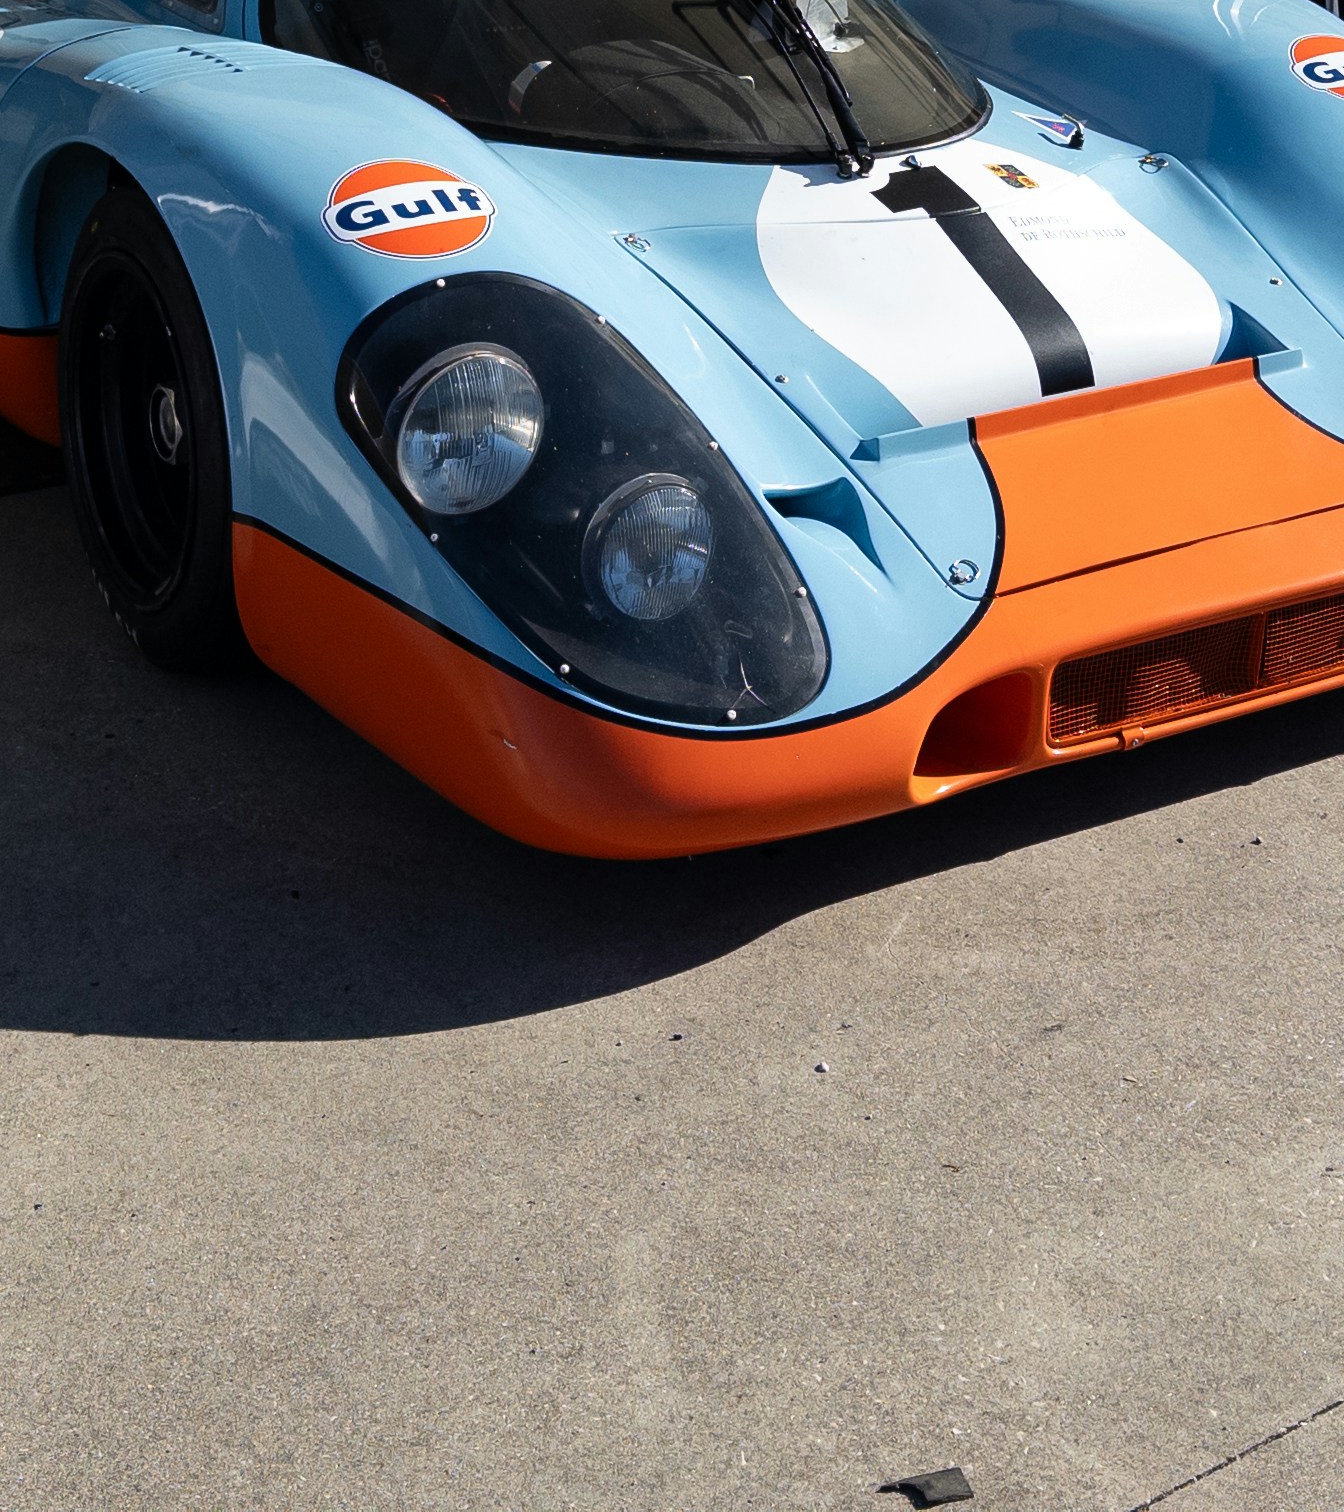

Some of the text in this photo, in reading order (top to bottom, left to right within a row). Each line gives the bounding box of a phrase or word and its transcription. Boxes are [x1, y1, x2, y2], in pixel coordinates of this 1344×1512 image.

[335, 188, 482, 232] Gulf
[1008, 216, 1070, 228] EDMOND
[1020, 228, 1126, 242] DE ROTHSCHILD
[870, 165, 1096, 397] 1
